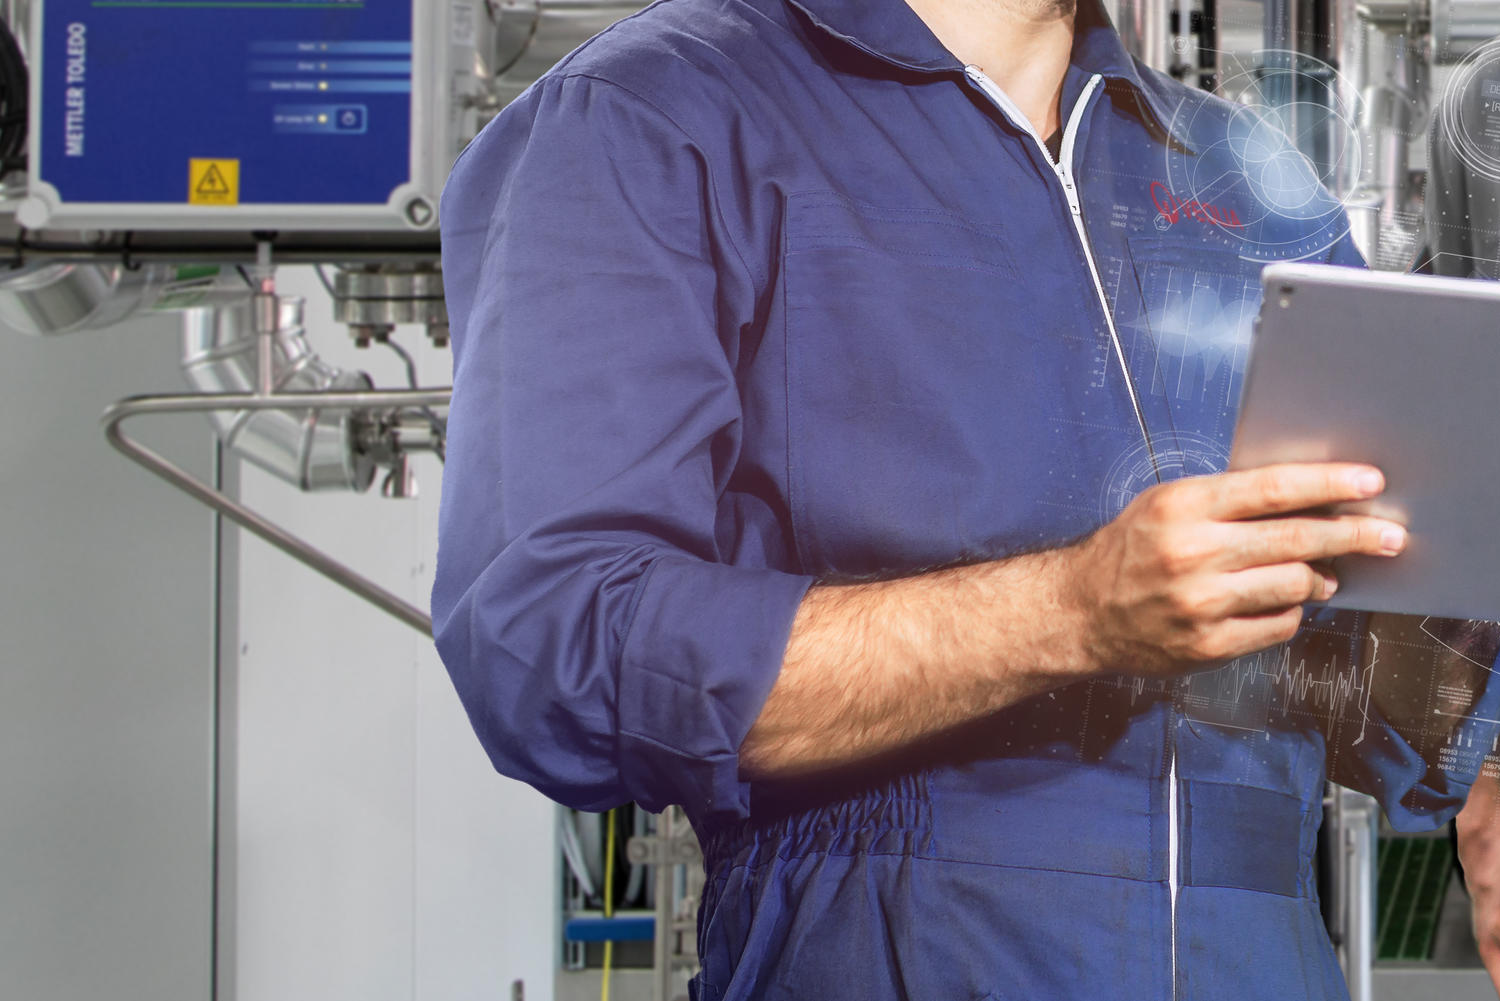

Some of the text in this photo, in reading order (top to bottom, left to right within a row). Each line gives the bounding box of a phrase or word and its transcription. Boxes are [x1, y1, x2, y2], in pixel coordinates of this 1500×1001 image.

[66, 22, 86, 157] METTLER TOLEDO
[1176, 196, 1245, 231] VEOLIA
